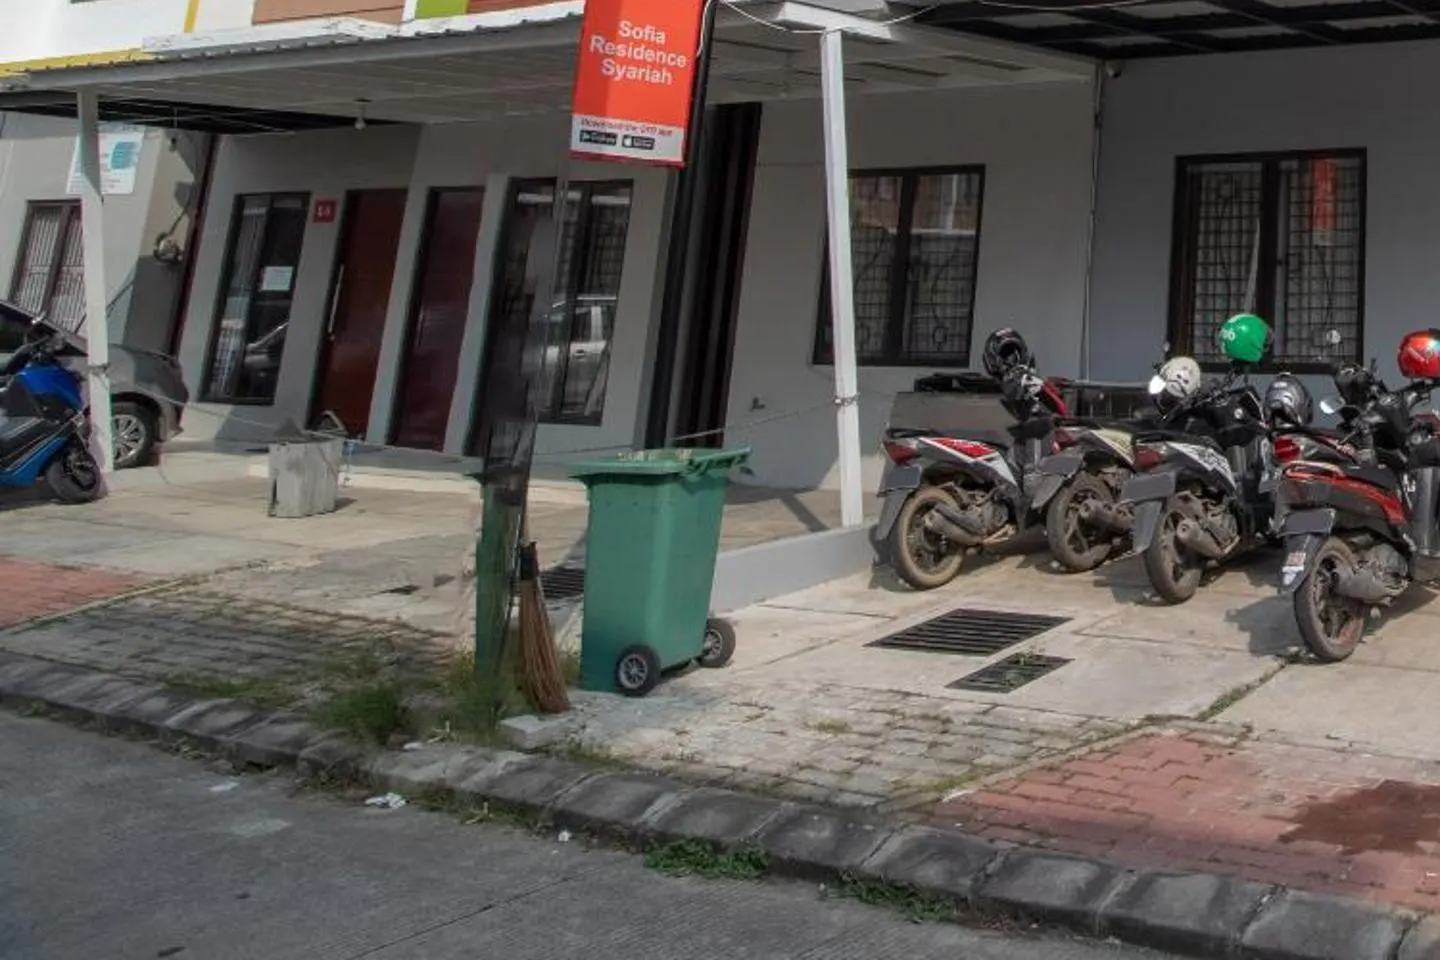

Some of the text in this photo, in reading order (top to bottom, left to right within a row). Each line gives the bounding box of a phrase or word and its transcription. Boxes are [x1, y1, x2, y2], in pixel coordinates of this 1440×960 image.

[619, 20, 666, 45] Sofia
[590, 34, 687, 68] Residence
[601, 58, 672, 85] Syariah
